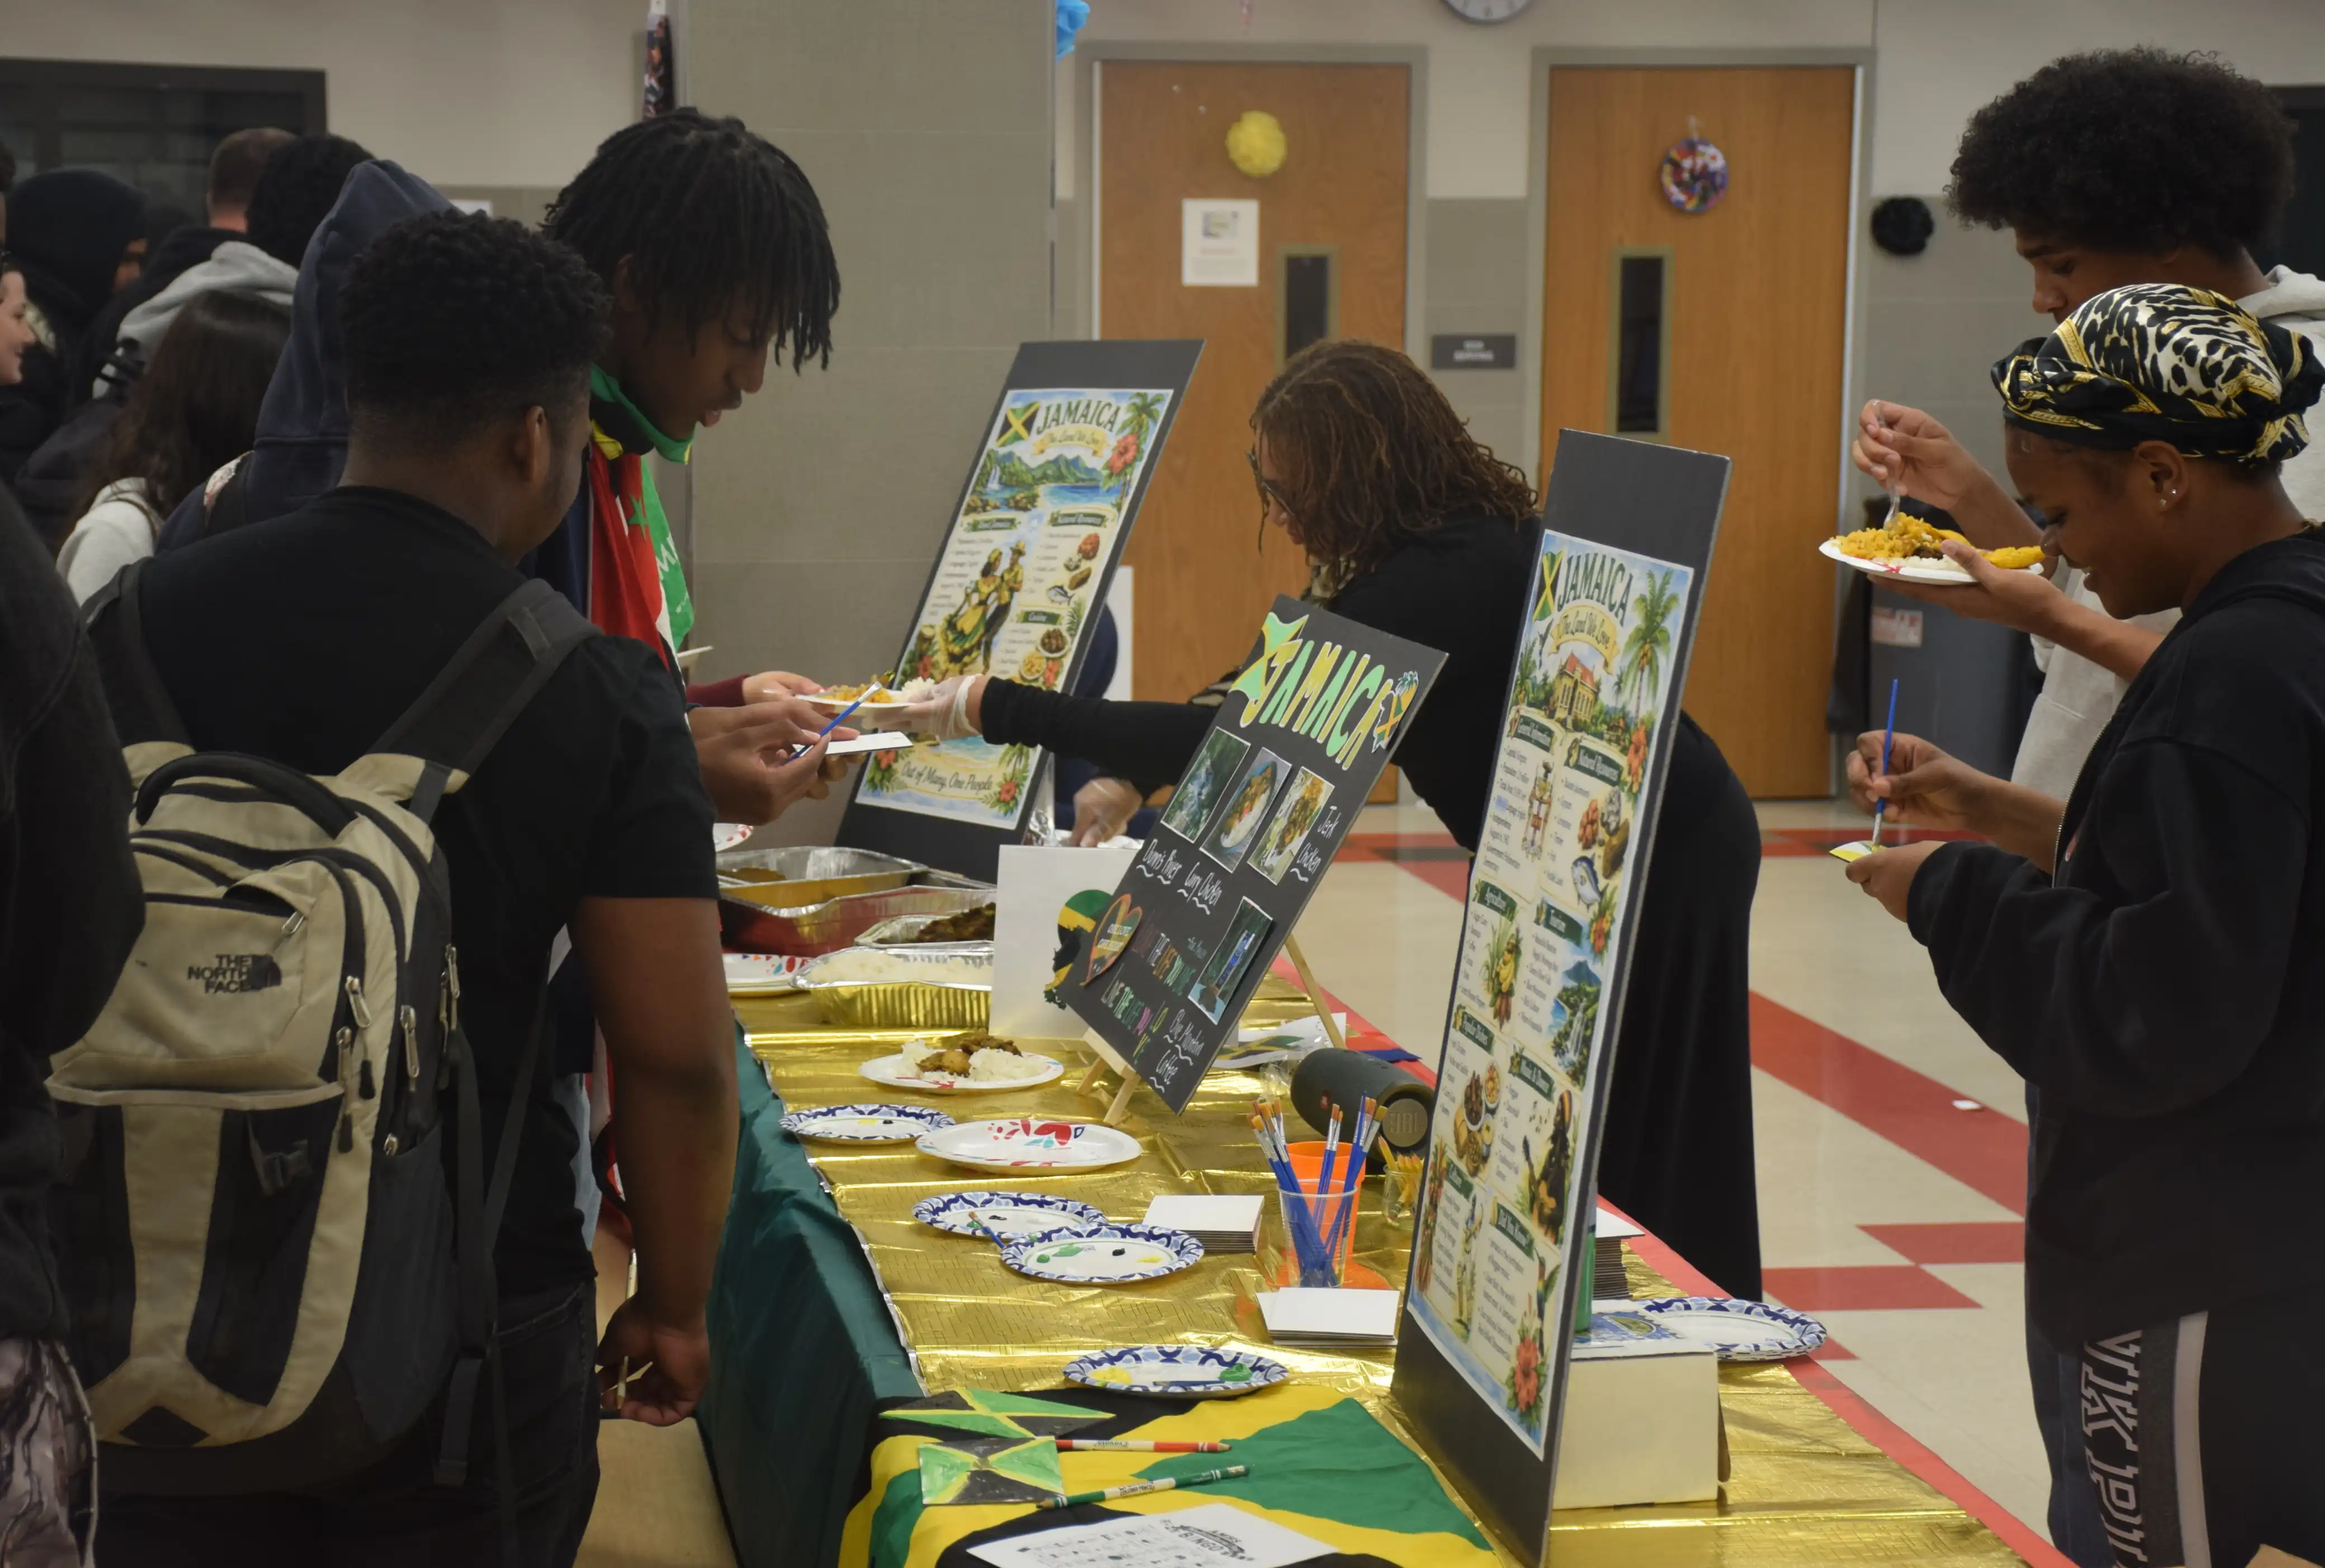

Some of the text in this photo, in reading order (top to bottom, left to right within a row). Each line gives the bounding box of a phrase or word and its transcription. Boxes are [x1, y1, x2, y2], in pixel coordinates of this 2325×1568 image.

[1036, 399, 1121, 435] JAMAICA
[1557, 552, 1633, 627] JAMAICA
[1559, 611, 1610, 650] The Land We Love
[1240, 639, 1393, 771] JAMAICA
[915, 766, 928, 785] of
[964, 774, 993, 795] People
[1577, 749, 1618, 782] Natural Resources
[1317, 806, 1341, 839] Jerk
[1142, 838, 1183, 880] Dunn's River
[1296, 842, 1321, 875] Chicken
[1197, 872, 1222, 906] Chicken
[216, 955, 252, 967] THE
[1147, 933, 1170, 967] THE
[188, 966, 251, 980] NORTH
[205, 980, 252, 994] FACE
[1113, 986, 1134, 1019] THE
[1156, 1050, 1178, 1085] Coffee
[1498, 1208, 1509, 1229] Did
[1178, 1532, 1225, 1551] BINGO
